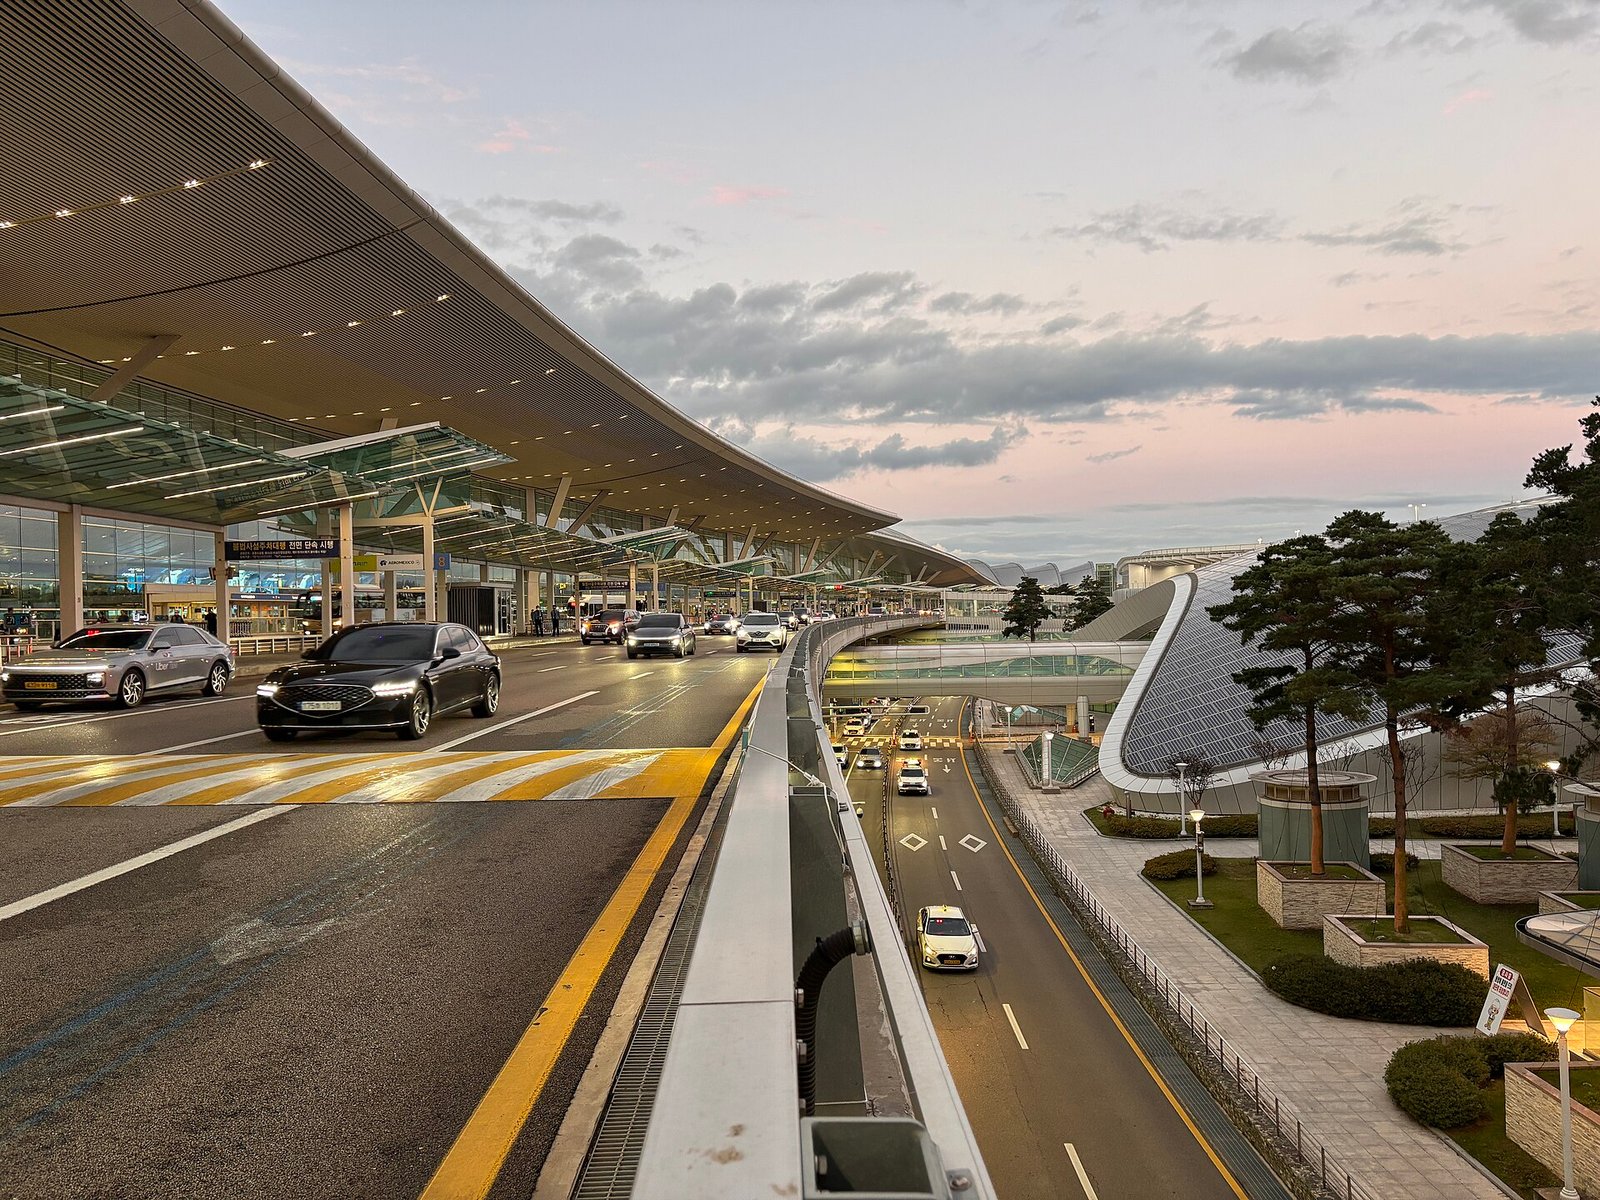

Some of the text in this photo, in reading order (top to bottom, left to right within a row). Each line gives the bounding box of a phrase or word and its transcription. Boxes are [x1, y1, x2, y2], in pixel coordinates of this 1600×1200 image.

[288, 541, 303, 550] 전면
[304, 541, 319, 550] 단속
[320, 540, 334, 550] 시행
[438, 556, 445, 567] 8
[155, 662, 169, 671] Uber
